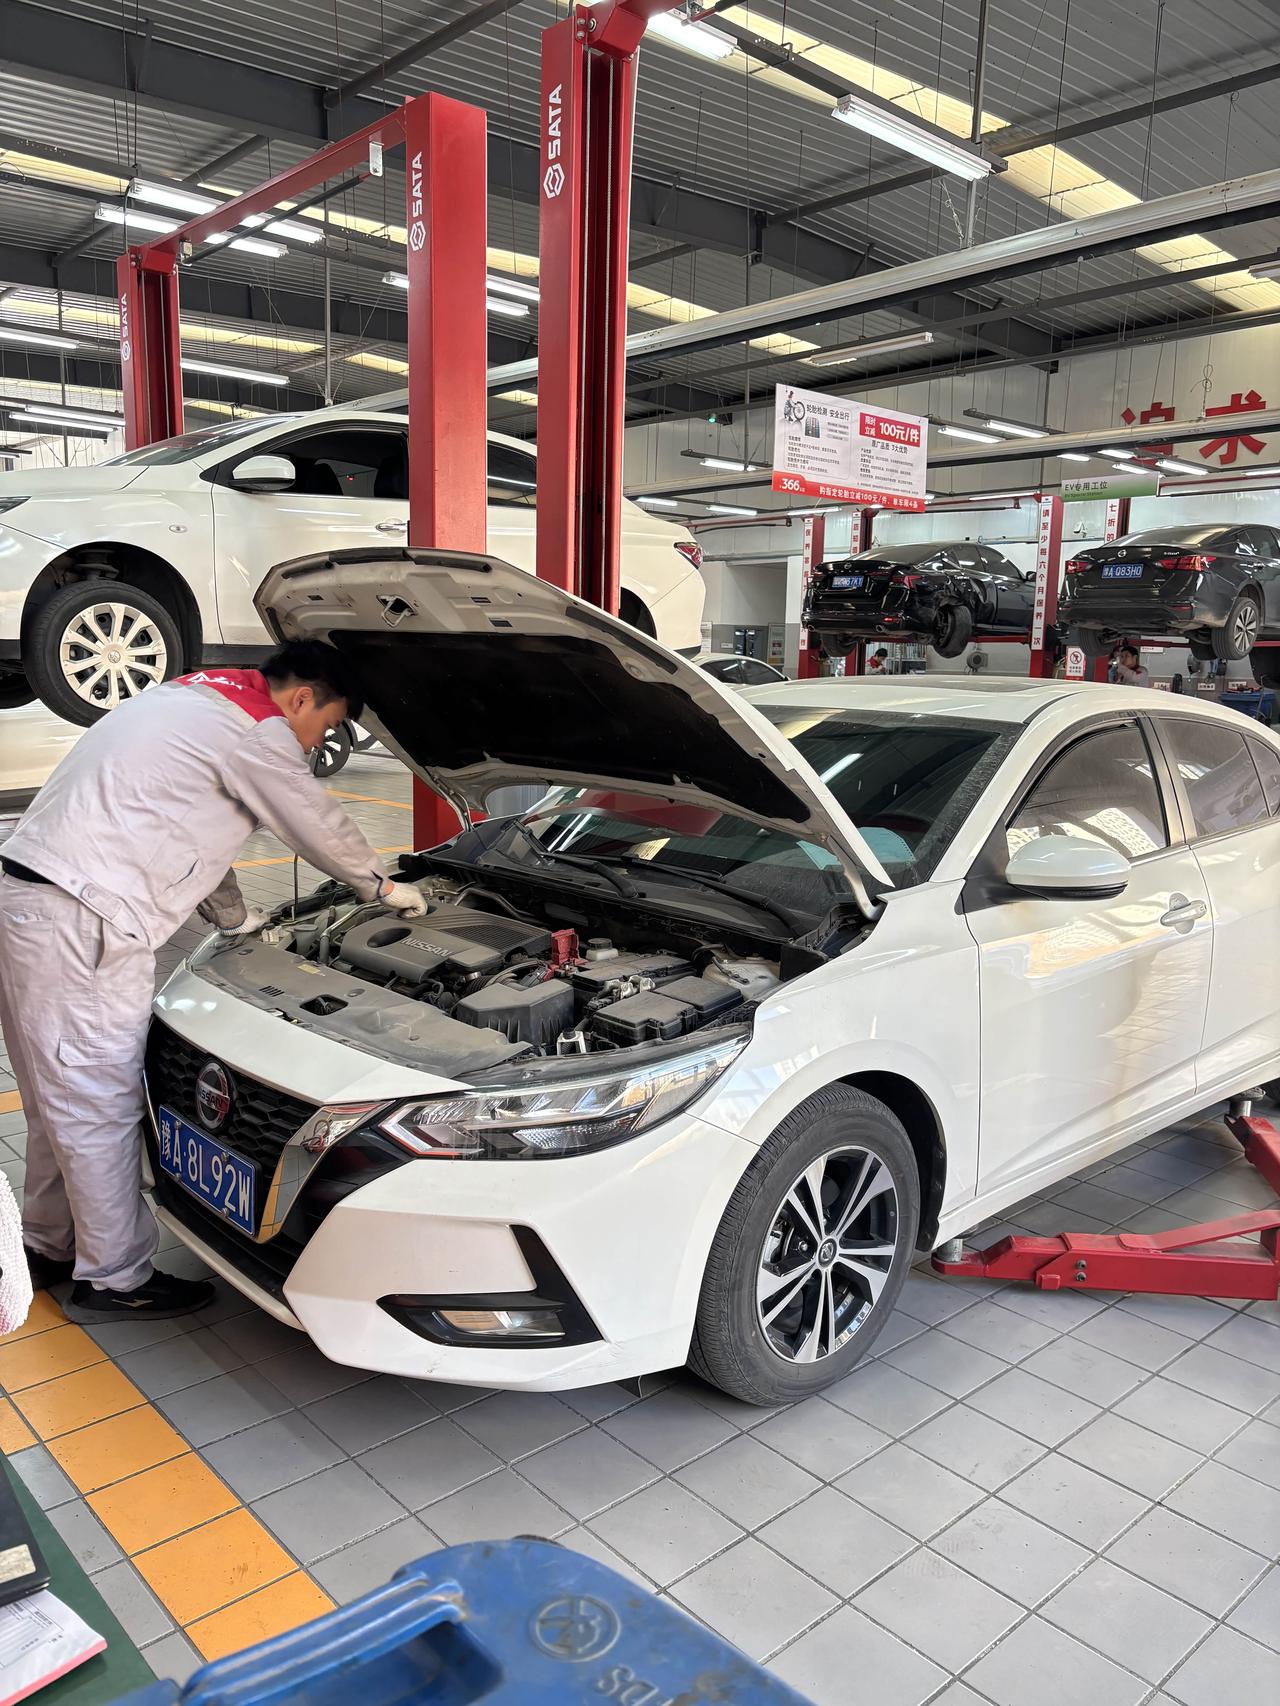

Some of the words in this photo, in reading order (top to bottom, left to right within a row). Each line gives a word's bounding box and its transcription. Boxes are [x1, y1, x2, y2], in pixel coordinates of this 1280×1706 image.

[548, 83, 562, 160] SATA
[412, 151, 424, 217] SATA
[120, 293, 129, 337] SATA
[879, 422, 920, 444] 100元/件
[401, 936, 452, 957] NISSAN
